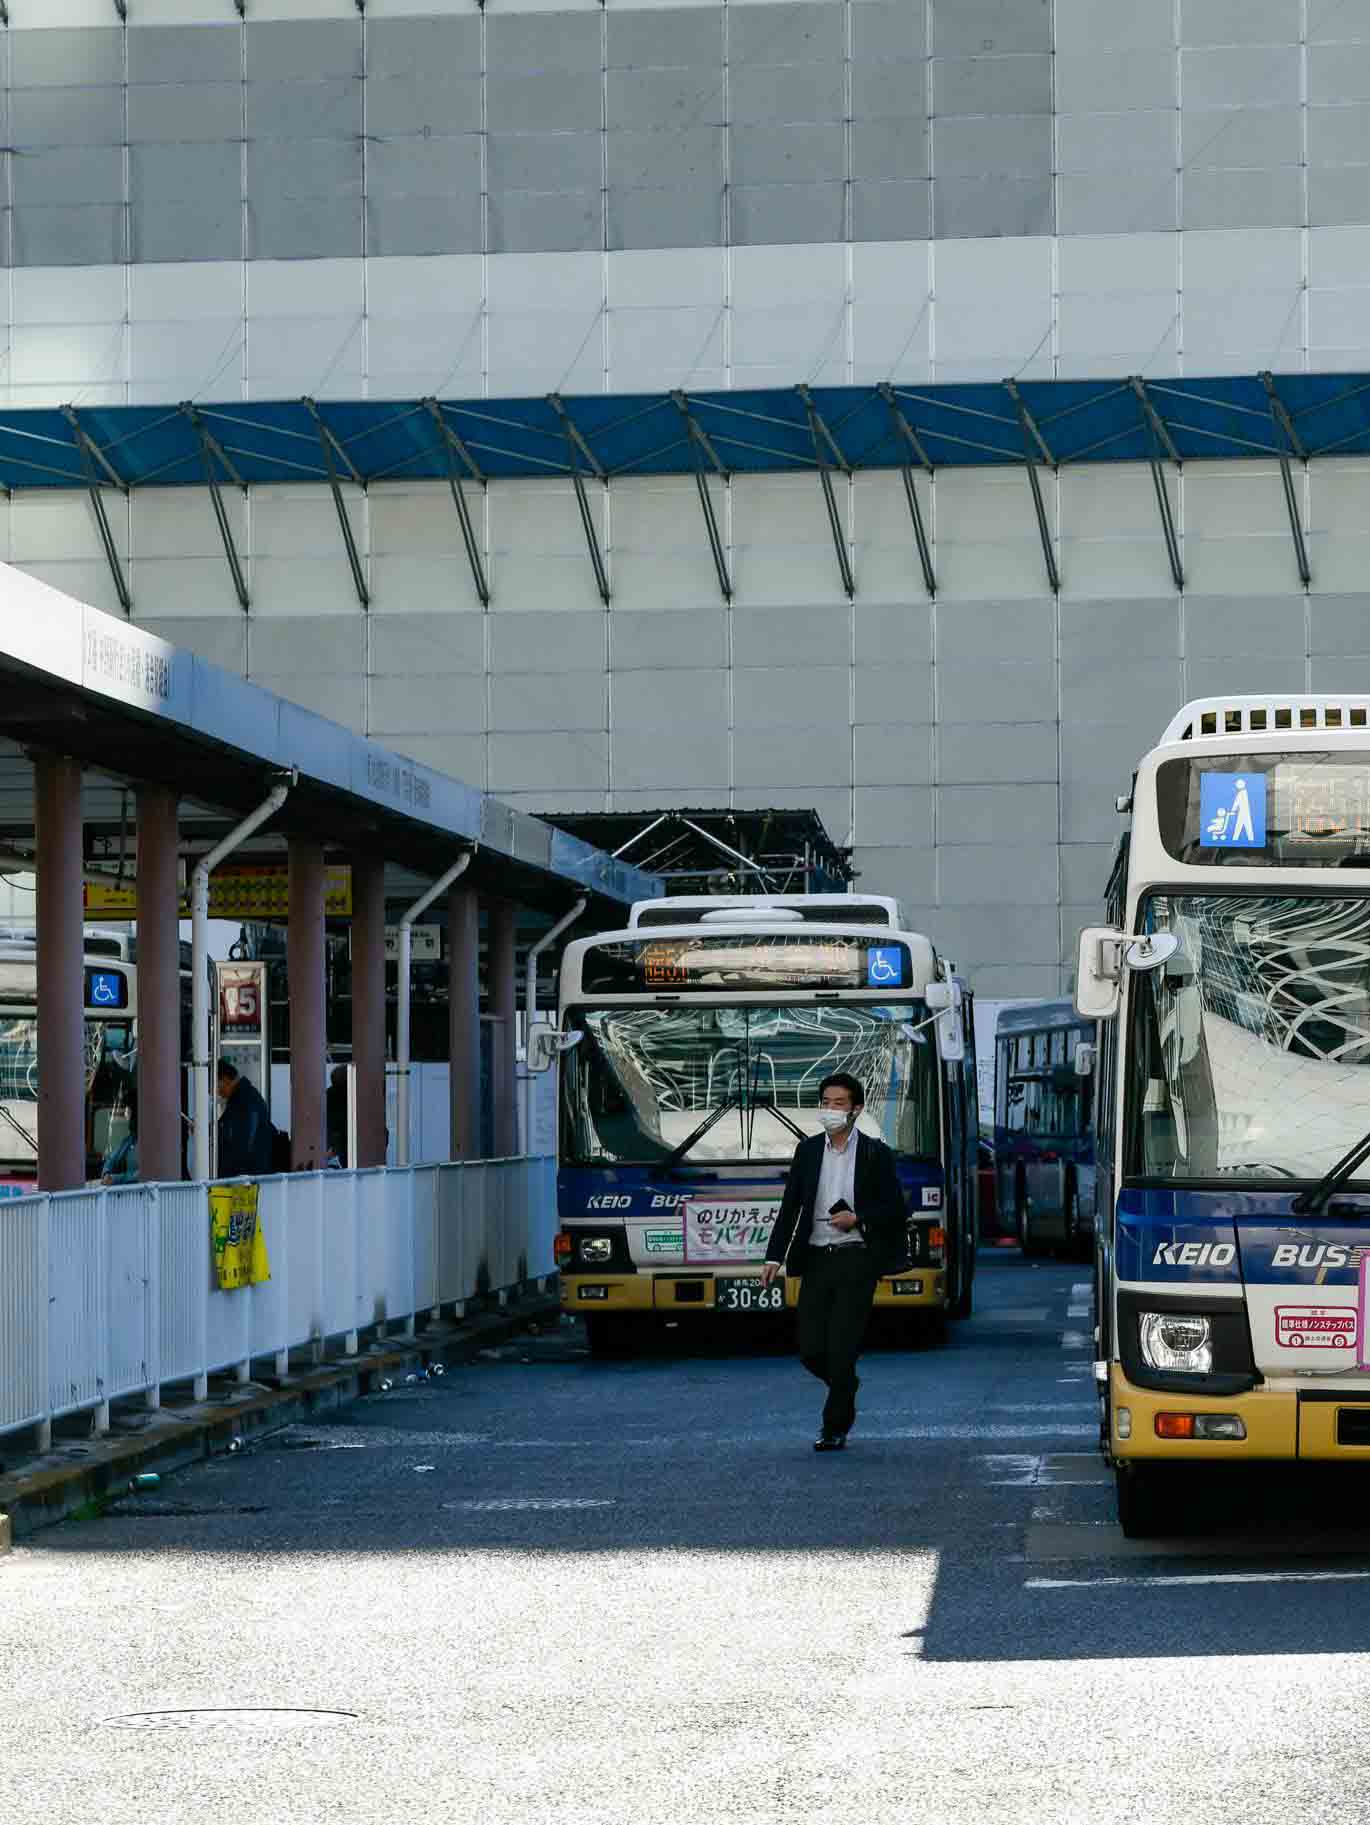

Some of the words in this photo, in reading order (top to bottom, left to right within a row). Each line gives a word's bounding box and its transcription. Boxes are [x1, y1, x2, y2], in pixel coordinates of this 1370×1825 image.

[586, 1195, 633, 1209] KEIO
[697, 1227, 769, 1246] モバイル
[1152, 1243, 1236, 1266] KEIO
[1271, 1244, 1348, 1268] BUS
